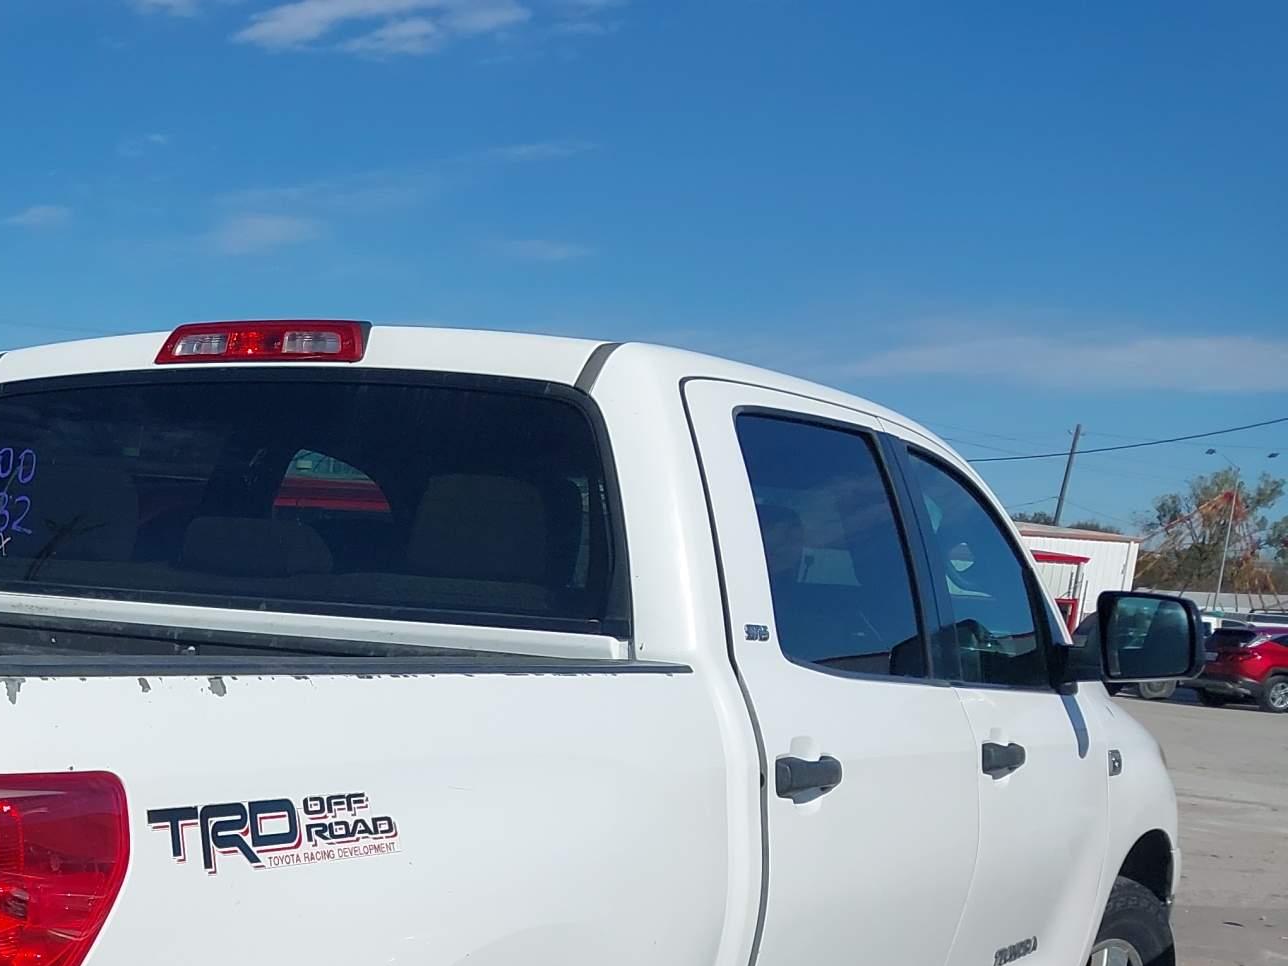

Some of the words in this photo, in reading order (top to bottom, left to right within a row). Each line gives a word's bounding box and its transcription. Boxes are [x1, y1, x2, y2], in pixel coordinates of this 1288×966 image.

[303, 792, 369, 819] OFF
[147, 798, 302, 875] TRD
[306, 816, 398, 846] ROAD
[268, 853, 302, 867] TOYOTA
[304, 849, 336, 864] RACING
[338, 842, 396, 859] DEVELOPMENT
